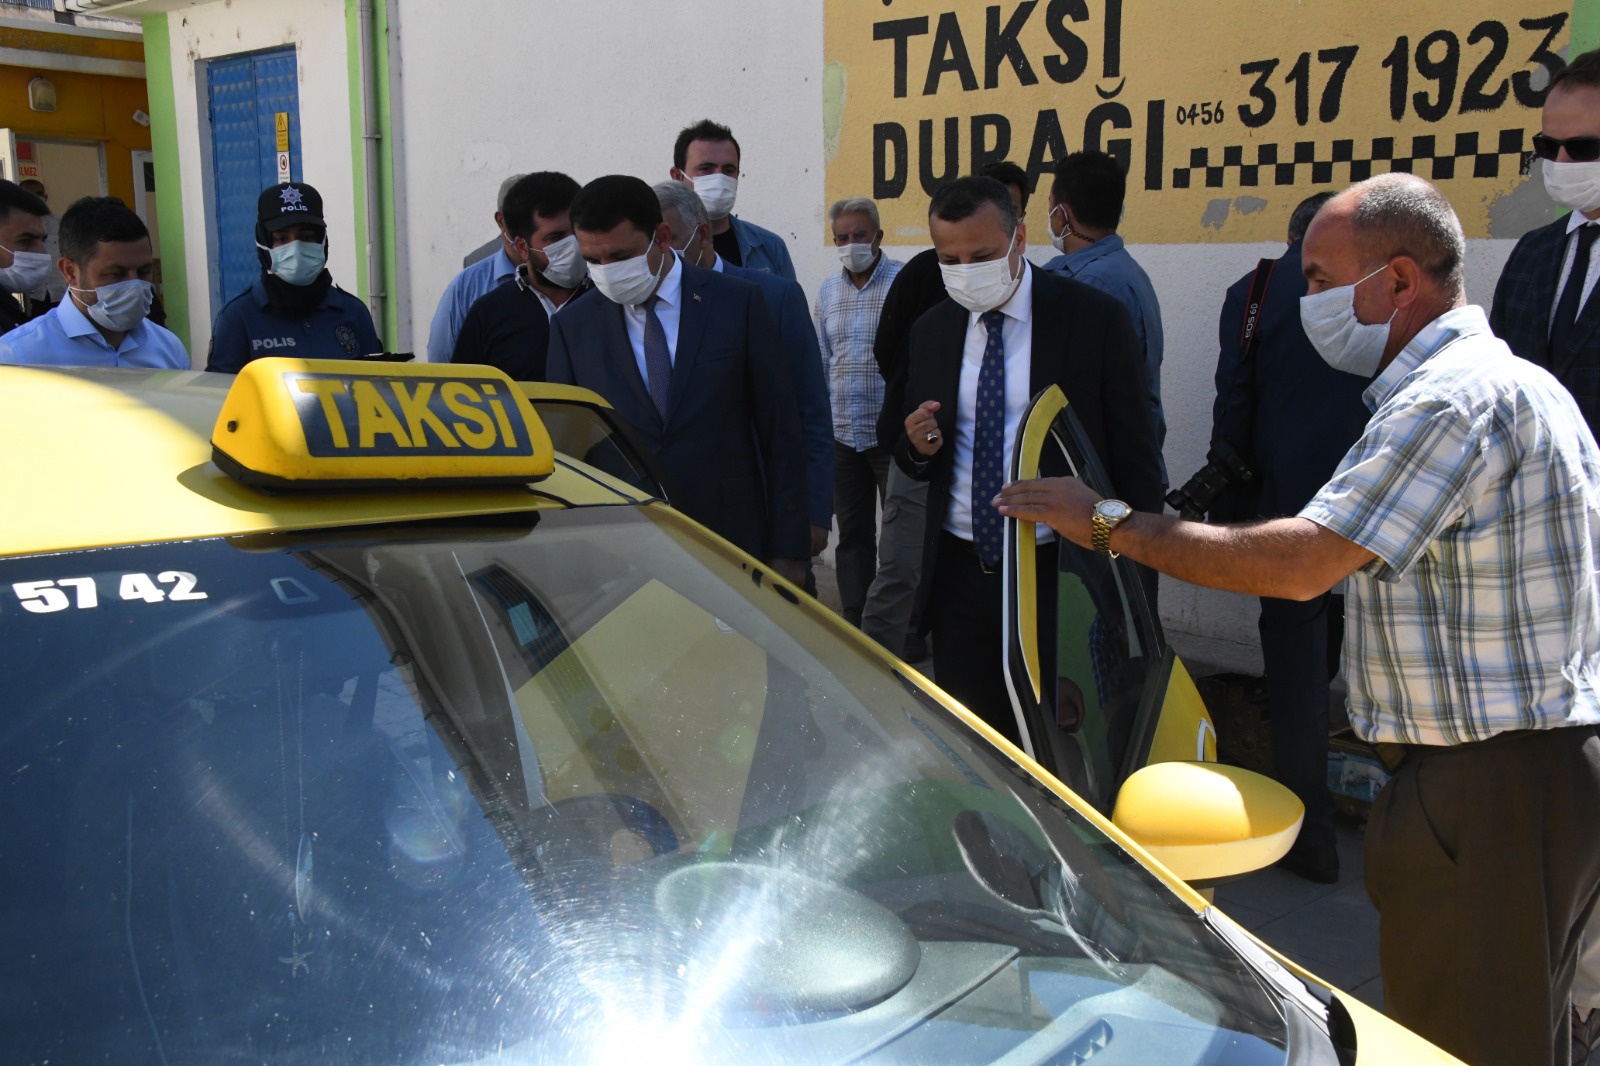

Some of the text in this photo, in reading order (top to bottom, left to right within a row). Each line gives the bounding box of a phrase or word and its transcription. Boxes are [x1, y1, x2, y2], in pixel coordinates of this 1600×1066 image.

[1176, 12, 1569, 128] 0456 317 1923
[1245, 316, 1255, 338] EOS
[12, 571, 208, 613] 57 42
